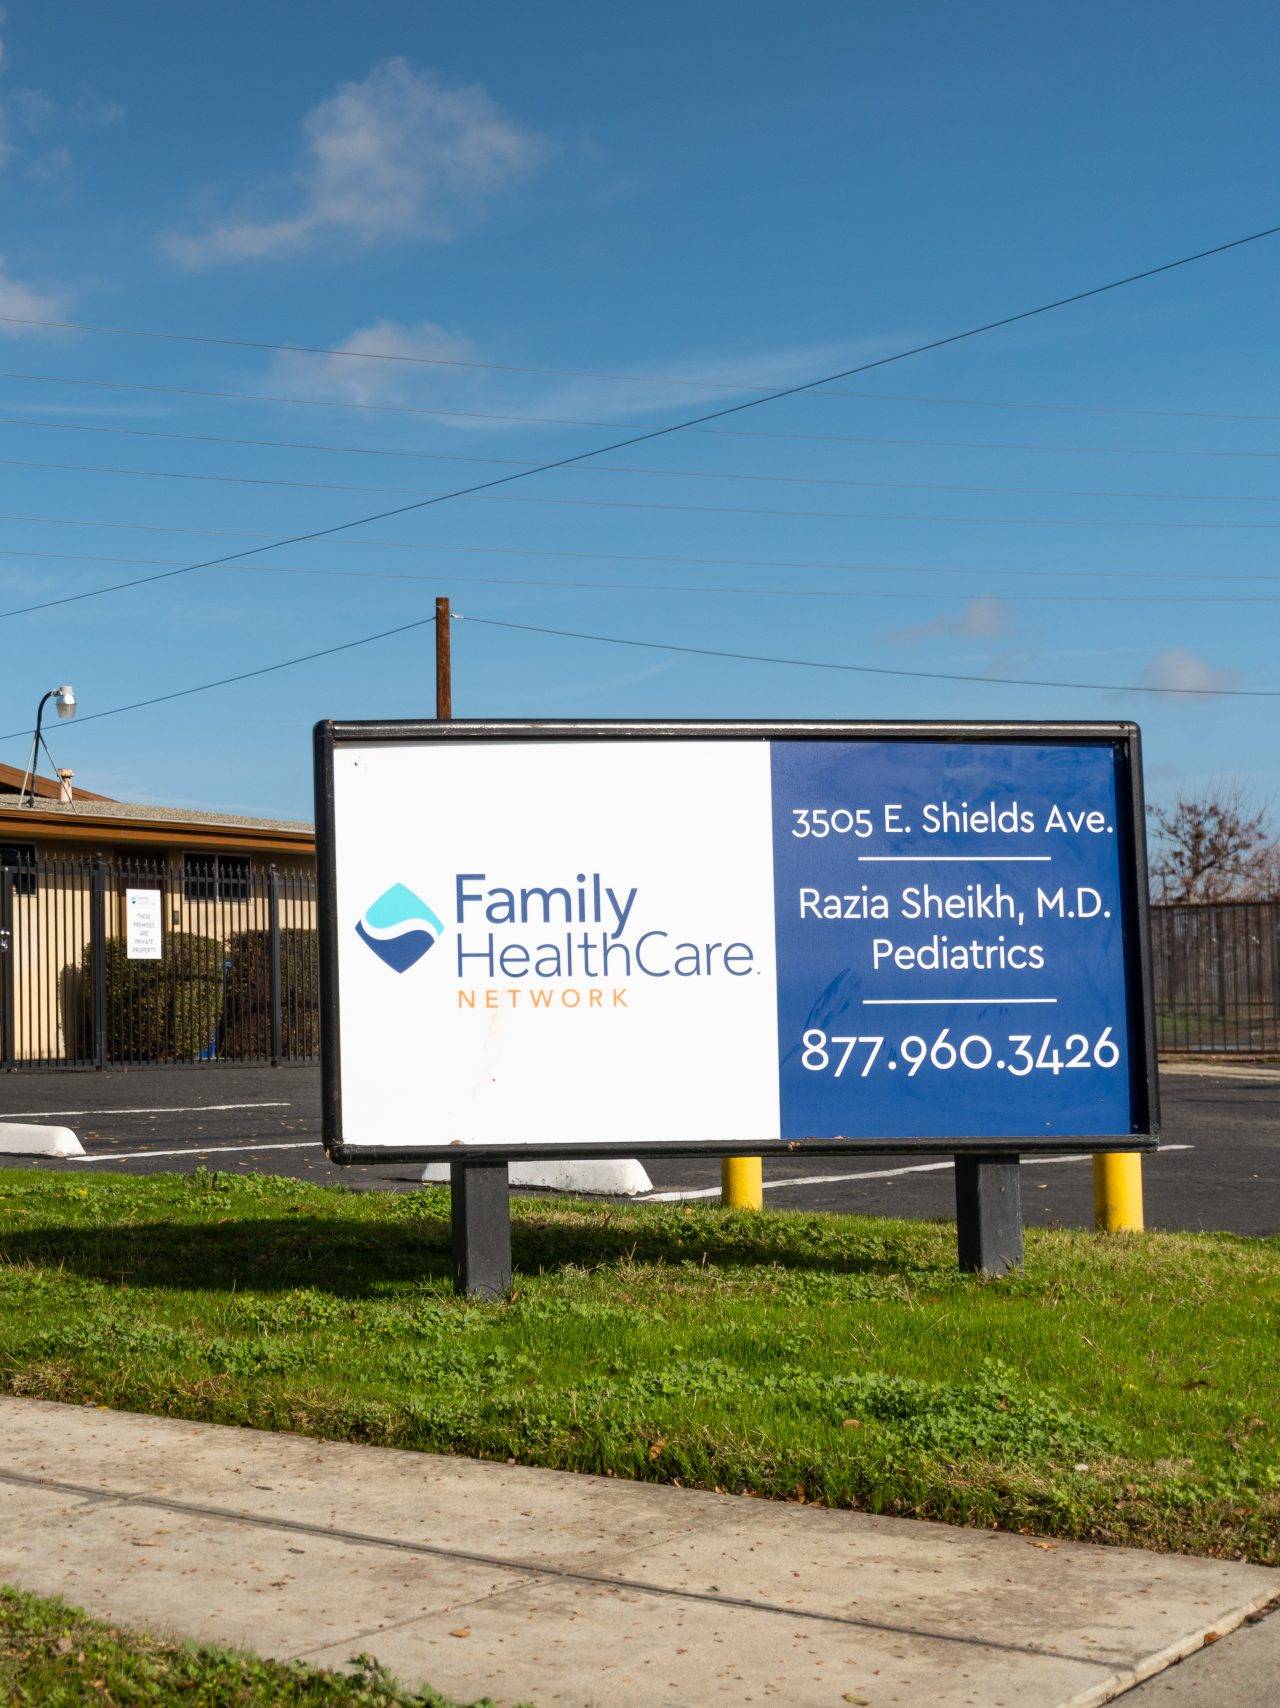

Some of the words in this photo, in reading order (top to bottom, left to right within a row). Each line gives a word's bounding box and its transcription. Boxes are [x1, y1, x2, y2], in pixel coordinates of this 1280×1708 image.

[792, 808, 874, 838] 3505
[884, 804, 911, 833] E.
[922, 801, 1035, 833] Shields
[1045, 804, 1114, 833] Ave.
[456, 873, 638, 939] Family
[799, 884, 889, 919] Razia
[901, 883, 1025, 925] Sheikh,
[1037, 887, 1111, 918] M.D.
[457, 931, 754, 978] HealthCare
[872, 934, 1045, 969] Pediatrics
[458, 989, 628, 1008] NETWORK
[801, 1026, 1120, 1078] 877.960.3426
